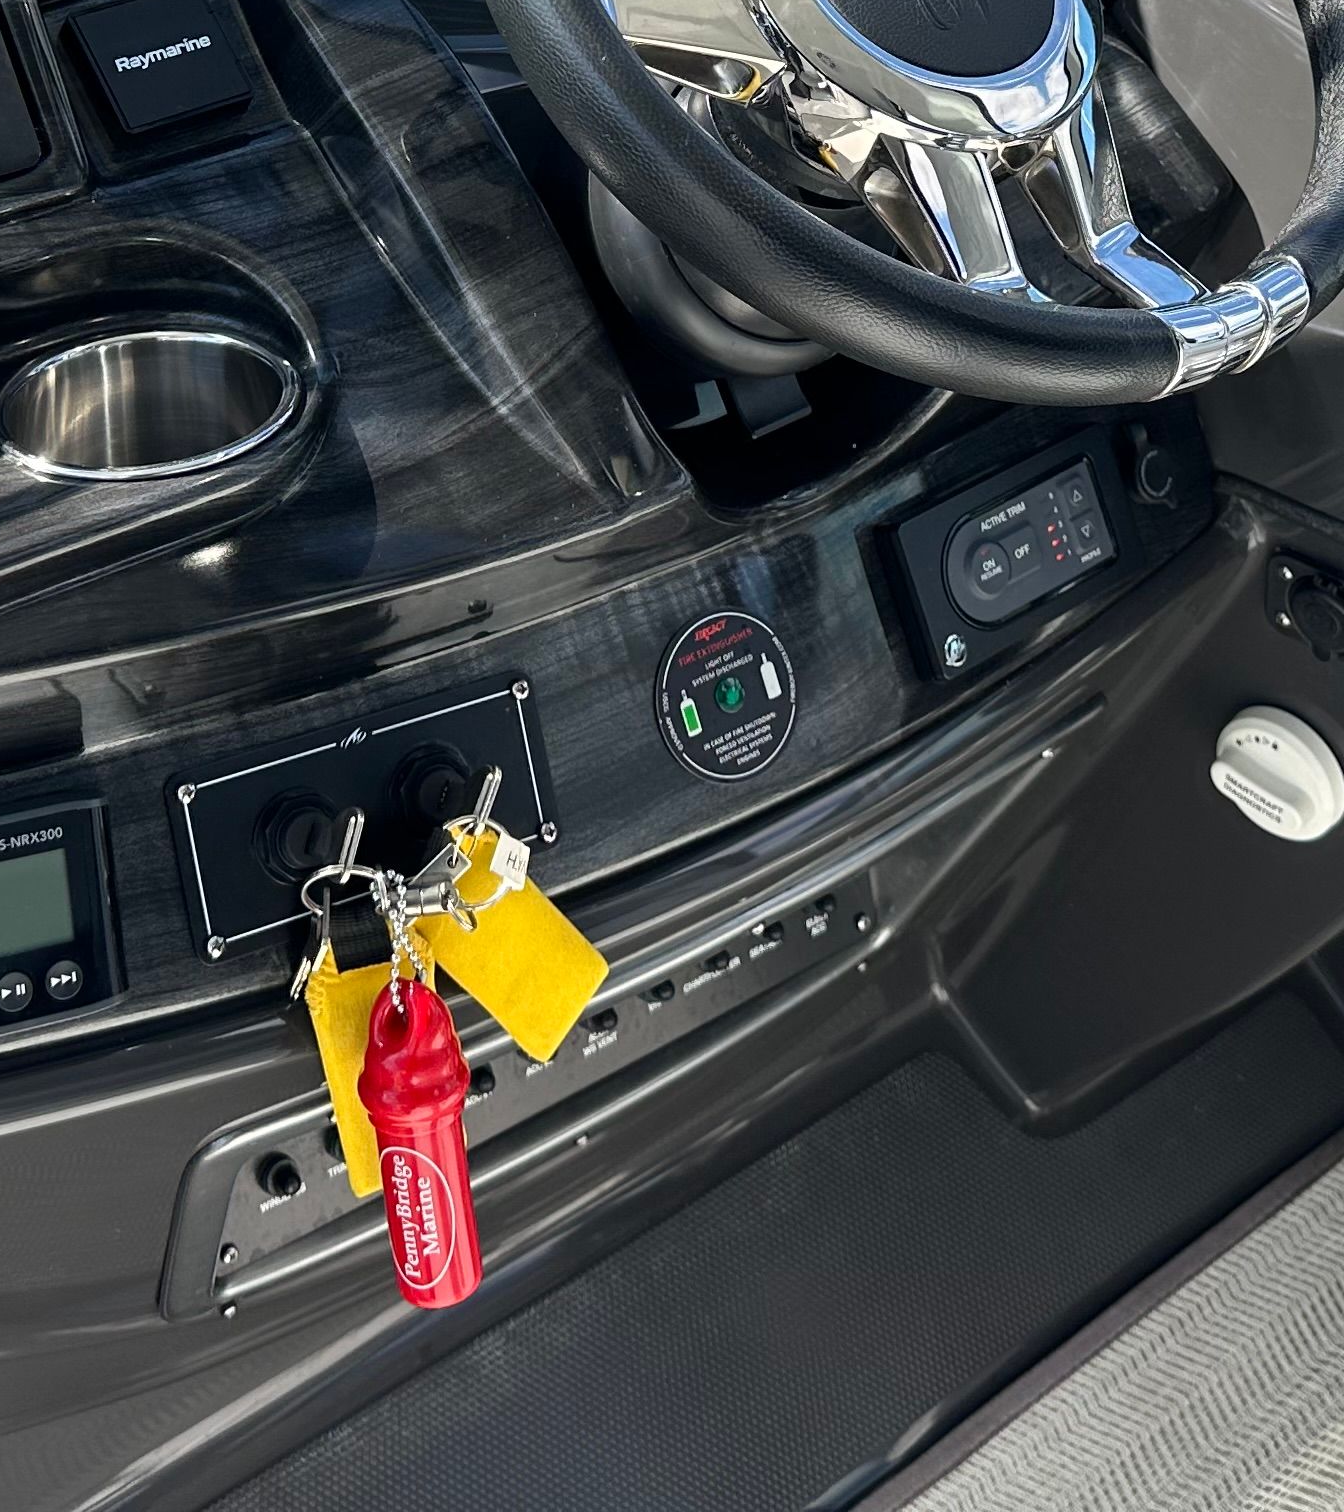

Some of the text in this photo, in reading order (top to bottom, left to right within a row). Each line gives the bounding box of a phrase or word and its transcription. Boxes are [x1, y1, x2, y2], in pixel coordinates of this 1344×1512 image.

[114, 36, 211, 72] Raymarine
[980, 501, 1026, 533] ACTIVE TRIM
[982, 557, 997, 572] ON
[1014, 543, 1031, 560] OFF
[678, 627, 754, 668] FIRE EXTINGUISHER
[704, 651, 735, 670] LIGHT OFF
[691, 653, 754, 687] SYSTEM DISCHARGED
[1223, 782, 1281, 824] DIAGNOSTICS
[1225, 773, 1284, 814] SMARTCRAFT
[391, 1154, 422, 1279] PennyBridge
[416, 1176, 441, 1257] Marine
